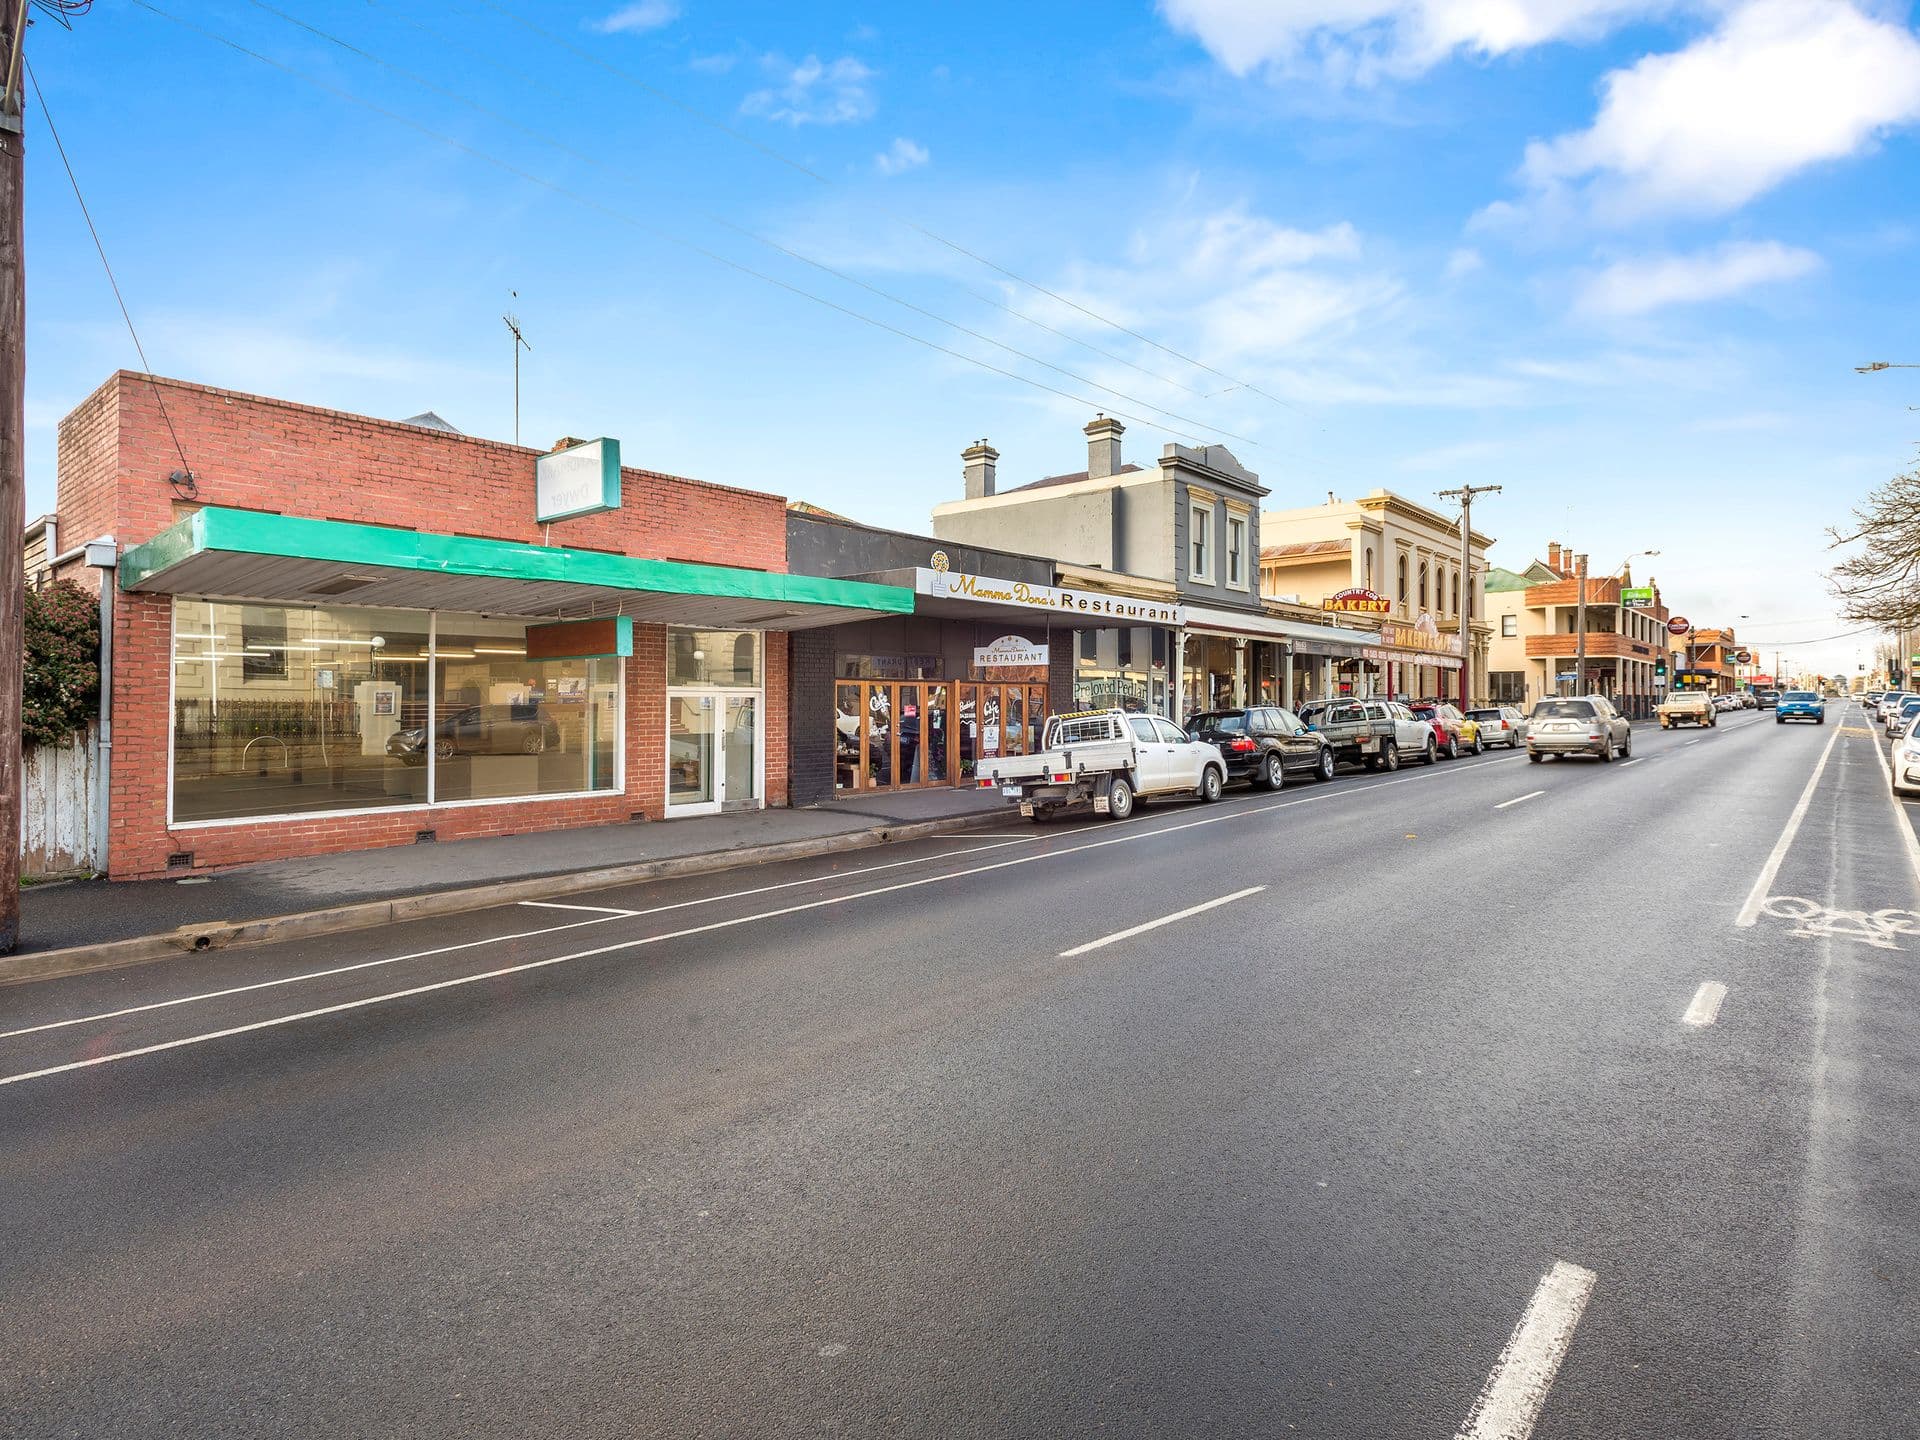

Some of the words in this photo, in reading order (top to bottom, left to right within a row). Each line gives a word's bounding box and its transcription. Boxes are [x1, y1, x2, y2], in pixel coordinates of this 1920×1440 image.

[950, 575, 1011, 601] Mamma
[1013, 583, 1055, 606] Dona's
[1062, 593, 1178, 621] Restaurant
[1335, 588, 1365, 600] COUNTRY
[1324, 600, 1389, 612] BAKERY
[1395, 627, 1428, 649] BAKERY
[980, 653, 1042, 662] RESTAURANT
[1074, 679, 1115, 698] Preloved
[1117, 681, 1147, 698] Pedlar
